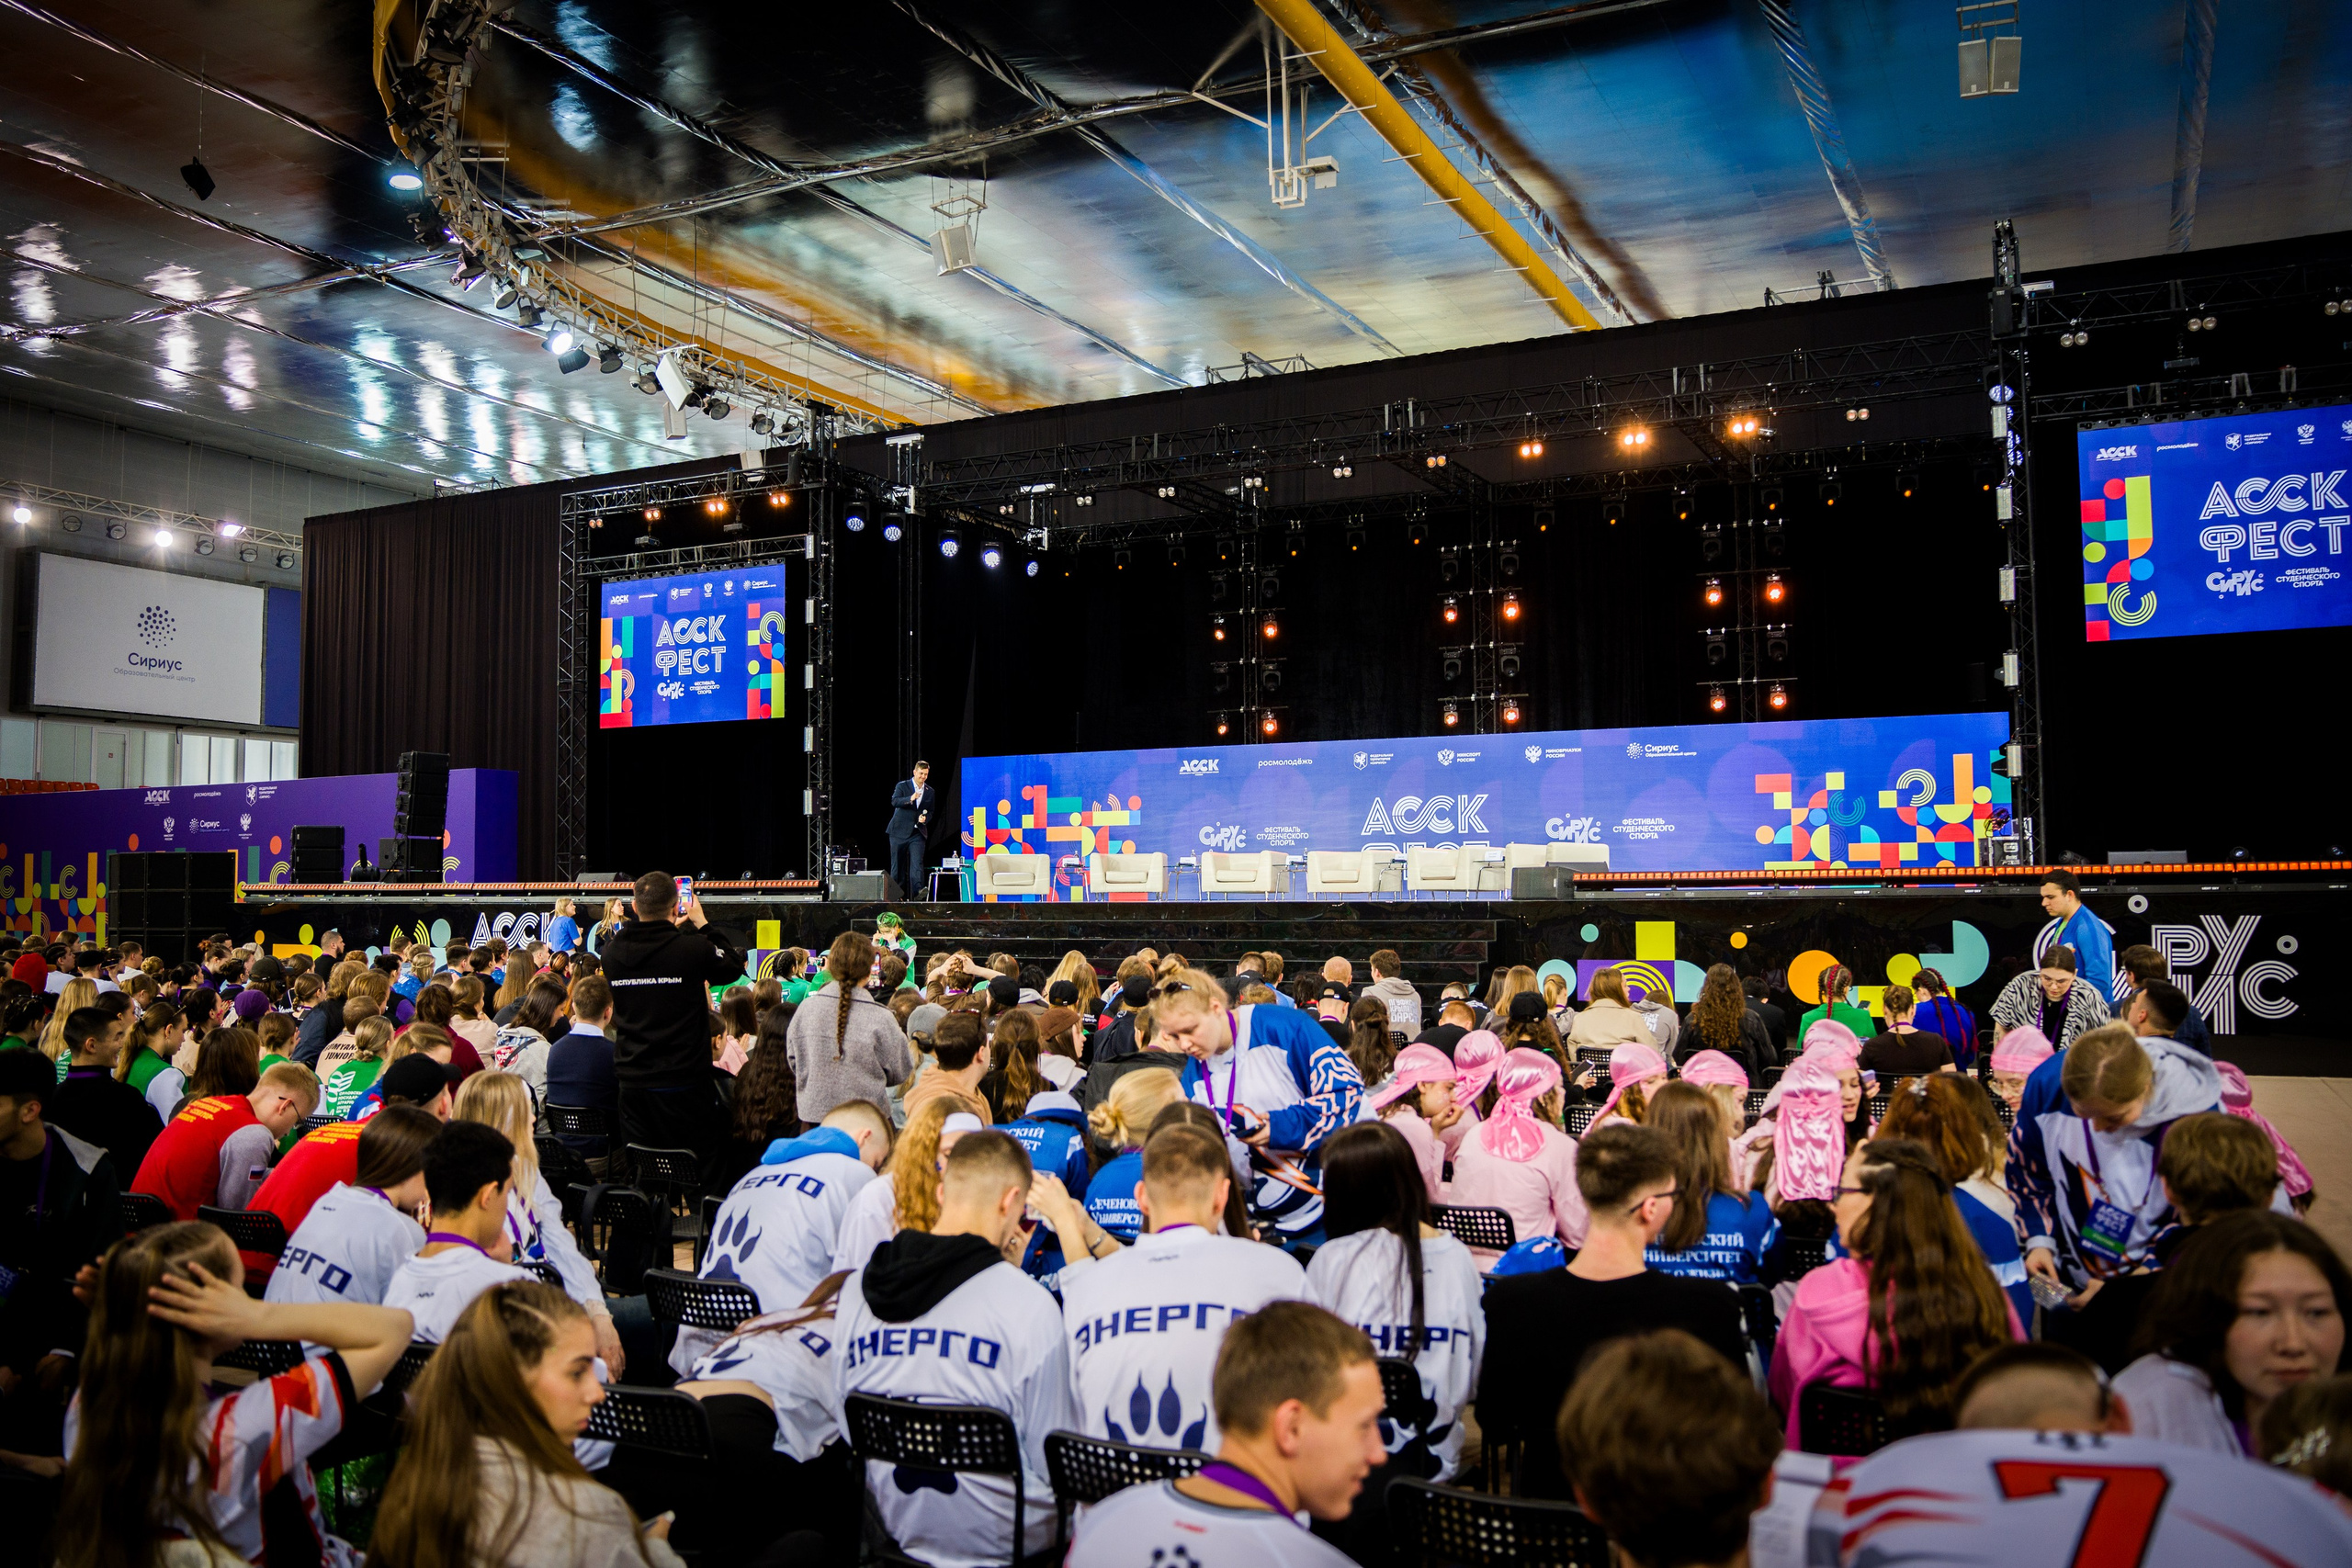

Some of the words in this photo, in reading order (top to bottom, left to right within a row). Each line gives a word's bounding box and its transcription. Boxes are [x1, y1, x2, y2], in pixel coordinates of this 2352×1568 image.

[2097, 446, 2137, 459] АССК
[2199, 469, 2349, 520] АССК
[2199, 514, 2351, 563] ФЕСТ
[2276, 572, 2340, 582] СТУДЕНЧЕСКОГО
[2285, 567, 2330, 575] ФЕСТИВАЛЬ
[2292, 580, 2324, 588] СПОРТА
[656, 615, 726, 648] АССК
[128, 652, 182, 672] Сириус
[655, 646, 726, 676] ФЕСТ
[113, 667, 175, 680] Образовательный
[1645, 744, 1679, 753] Сириус
[1179, 759, 1219, 773] АССК
[1361, 794, 1489, 836] АССК
[199, 819, 220, 829] Сириус
[1612, 824, 1675, 833] СТУДЕНЧЕСКОГО
[1643, 1249, 1741, 1263] НИВЕРСИТЕТ
[1075, 1304, 1248, 1354] ЭНЕРГ
[1991, 1458, 2172, 1568] 7
